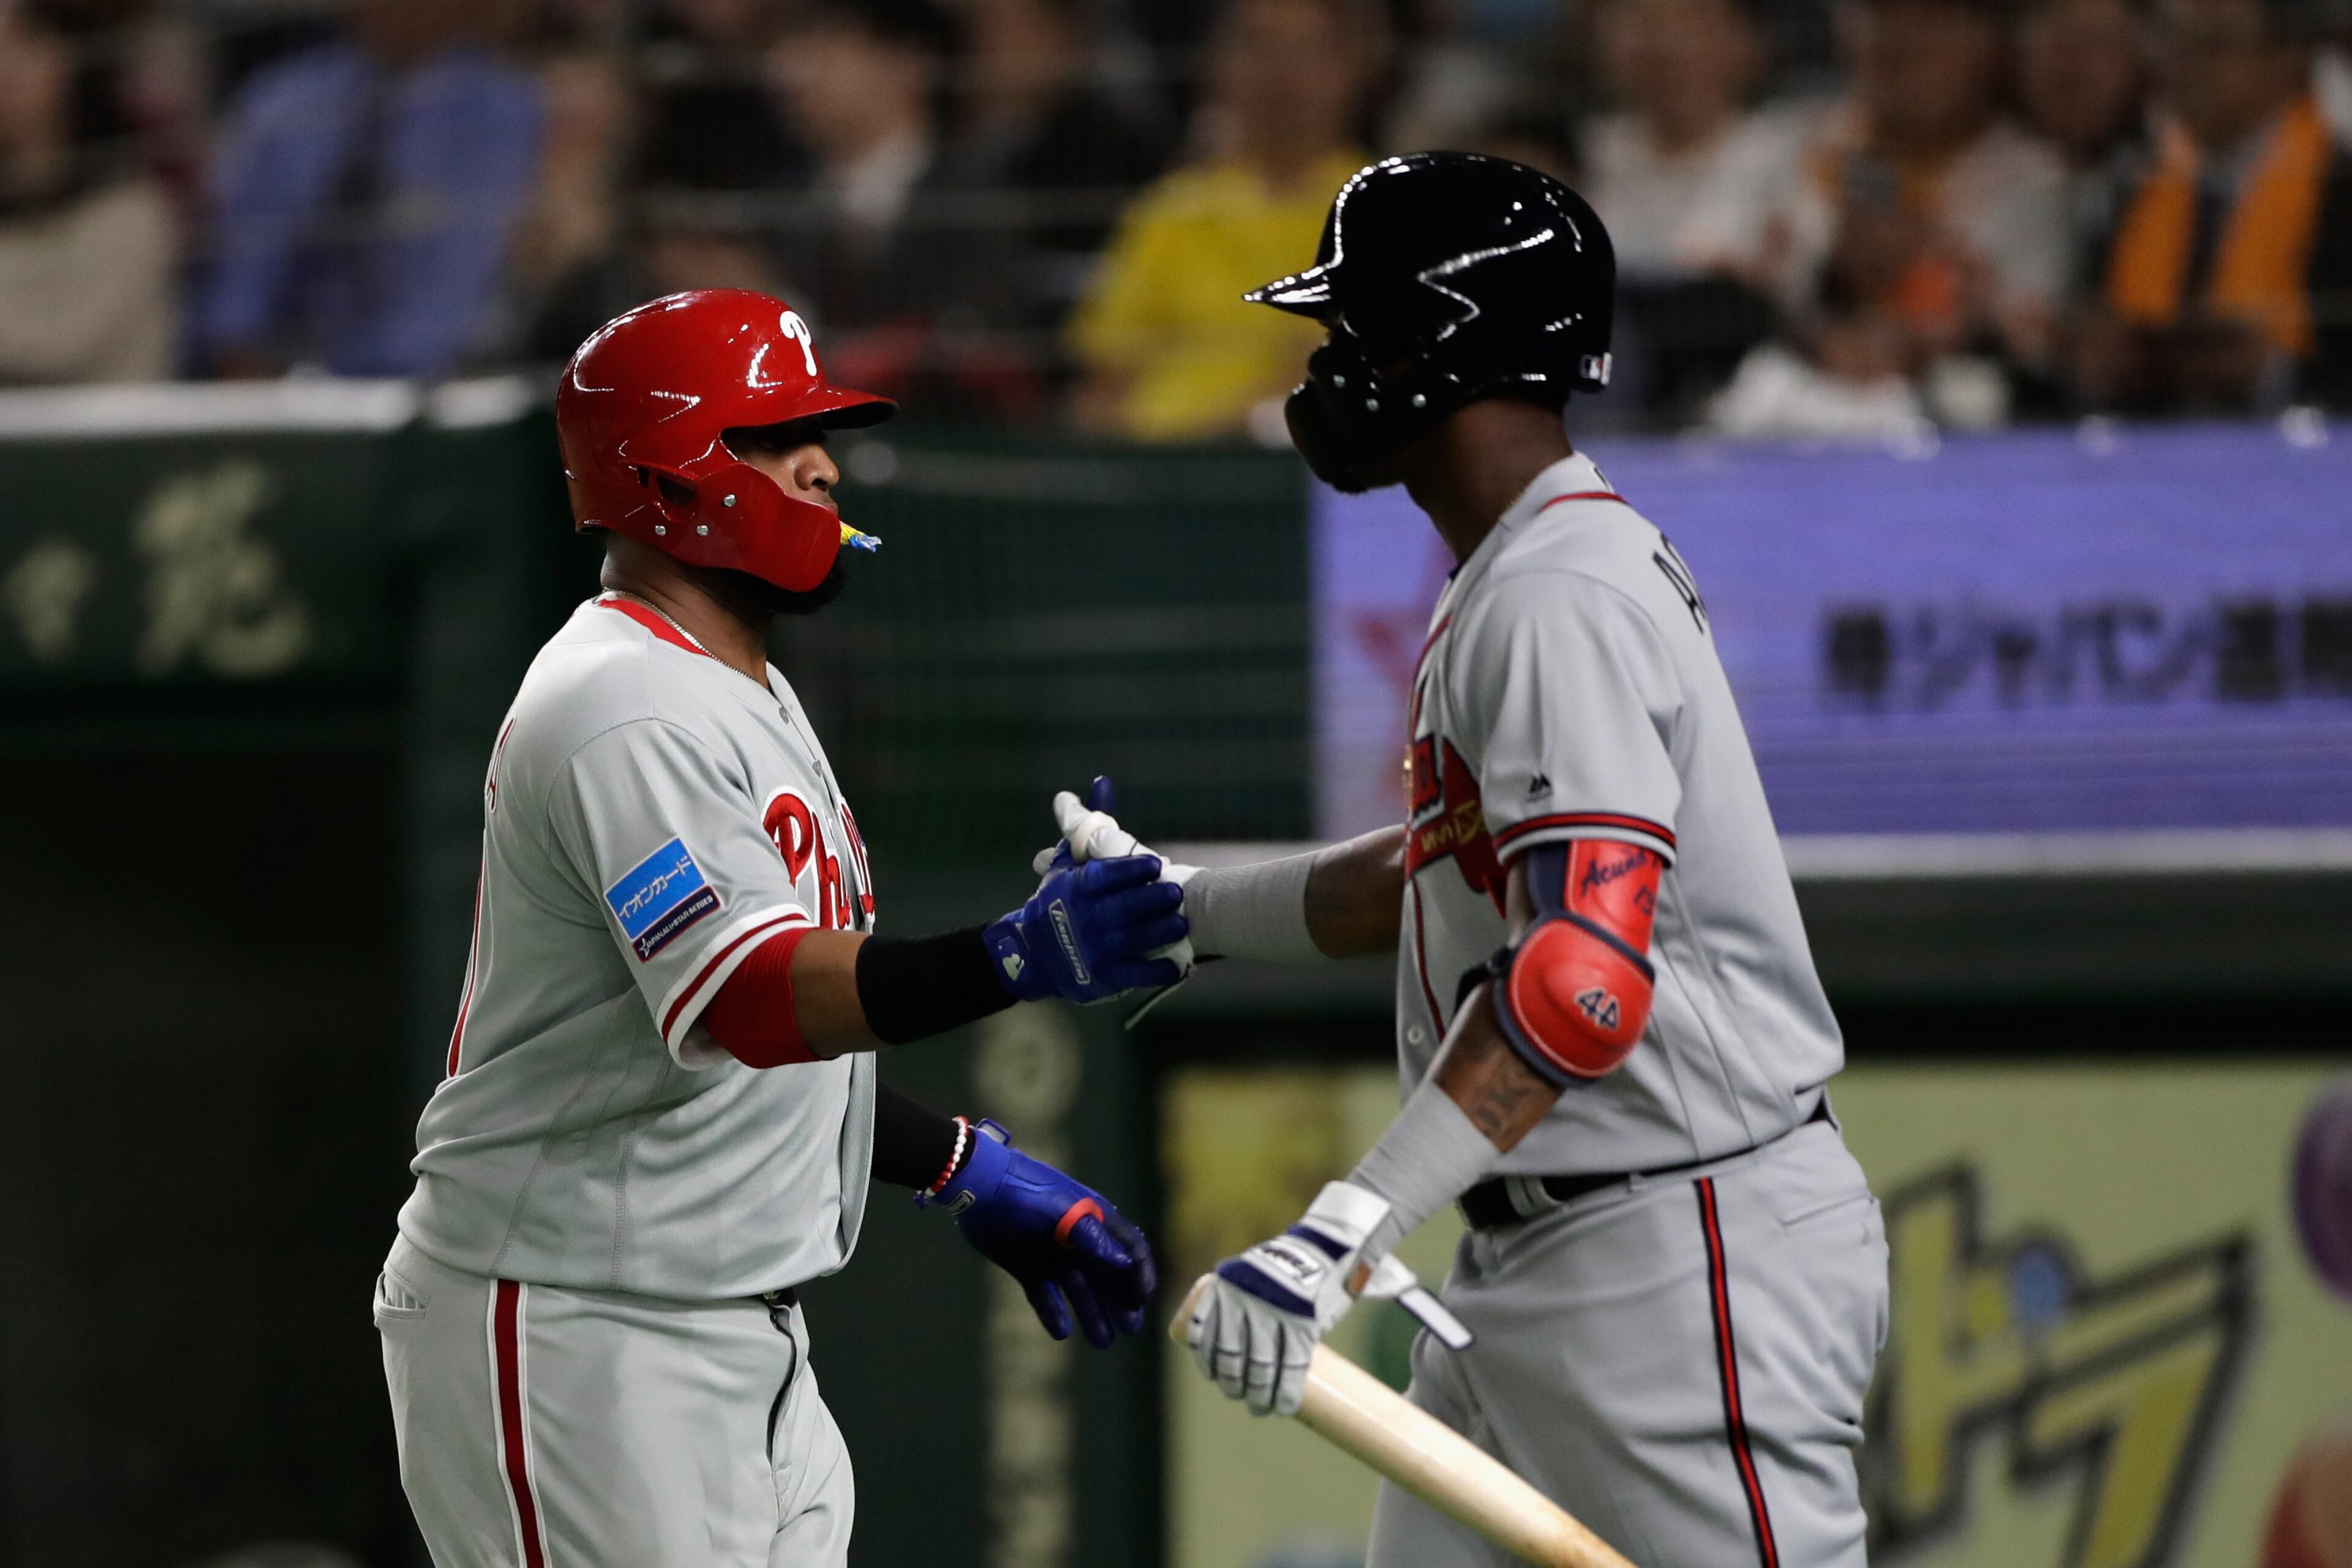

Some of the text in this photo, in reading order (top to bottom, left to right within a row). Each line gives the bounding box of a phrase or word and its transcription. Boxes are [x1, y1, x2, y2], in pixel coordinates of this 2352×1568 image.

[780, 311, 818, 377] P
[619, 856, 692, 919] イオンカード
[1576, 987, 1620, 1030] 44
